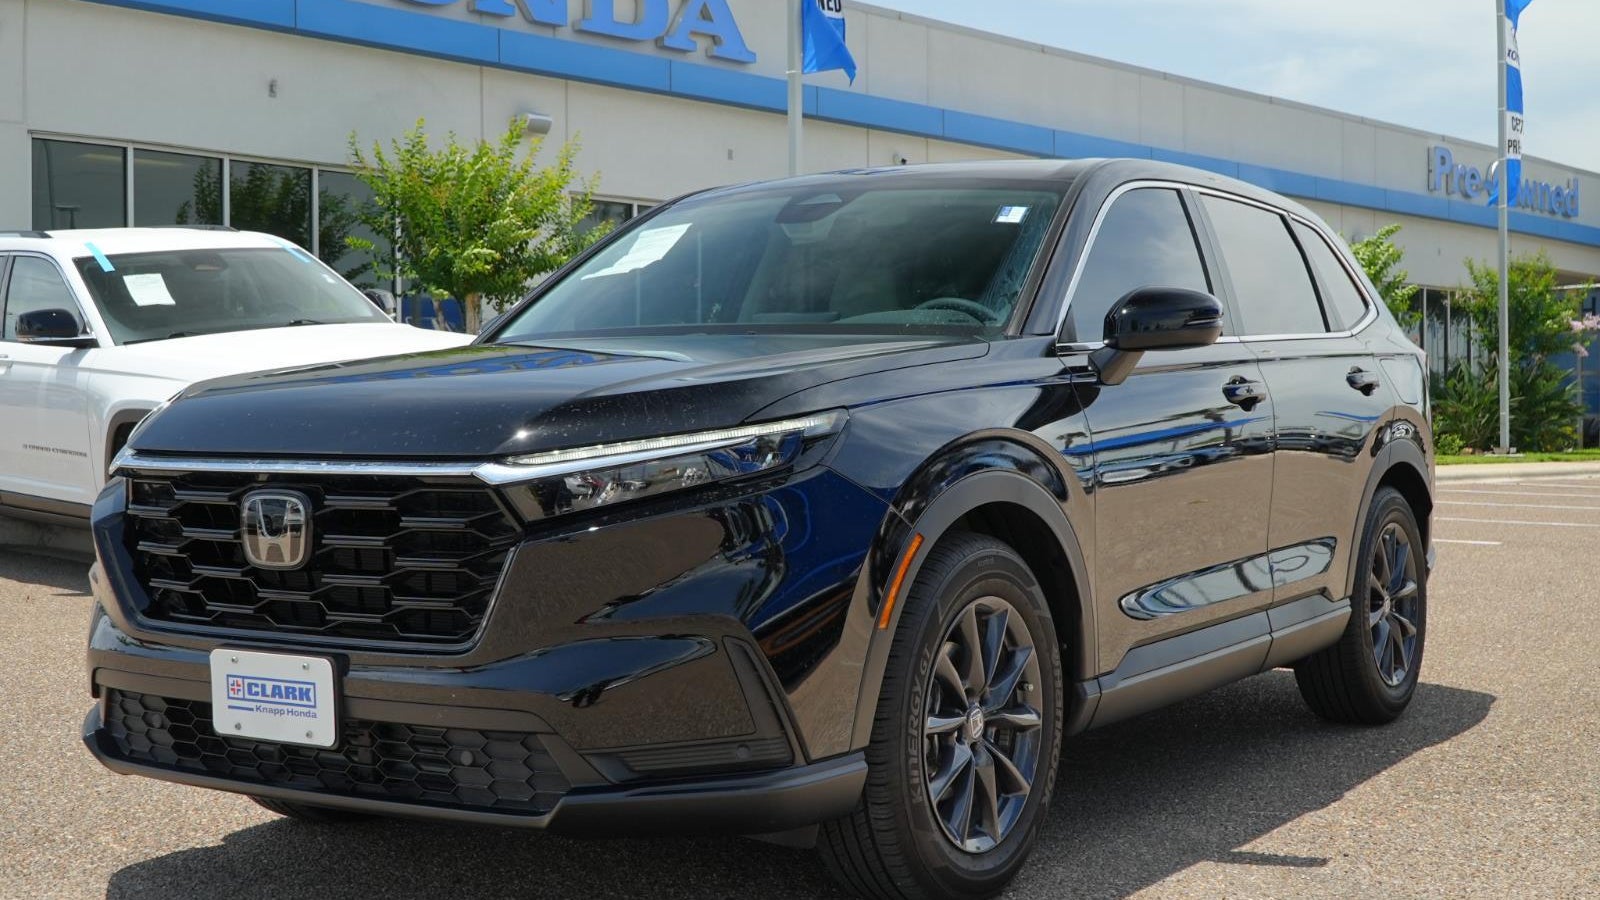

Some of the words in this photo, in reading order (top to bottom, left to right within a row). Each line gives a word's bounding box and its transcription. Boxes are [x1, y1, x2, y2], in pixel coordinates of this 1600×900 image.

[246, 682, 312, 702] CLARK
[255, 705, 285, 717] Knapp
[286, 708, 318, 719] Honda
